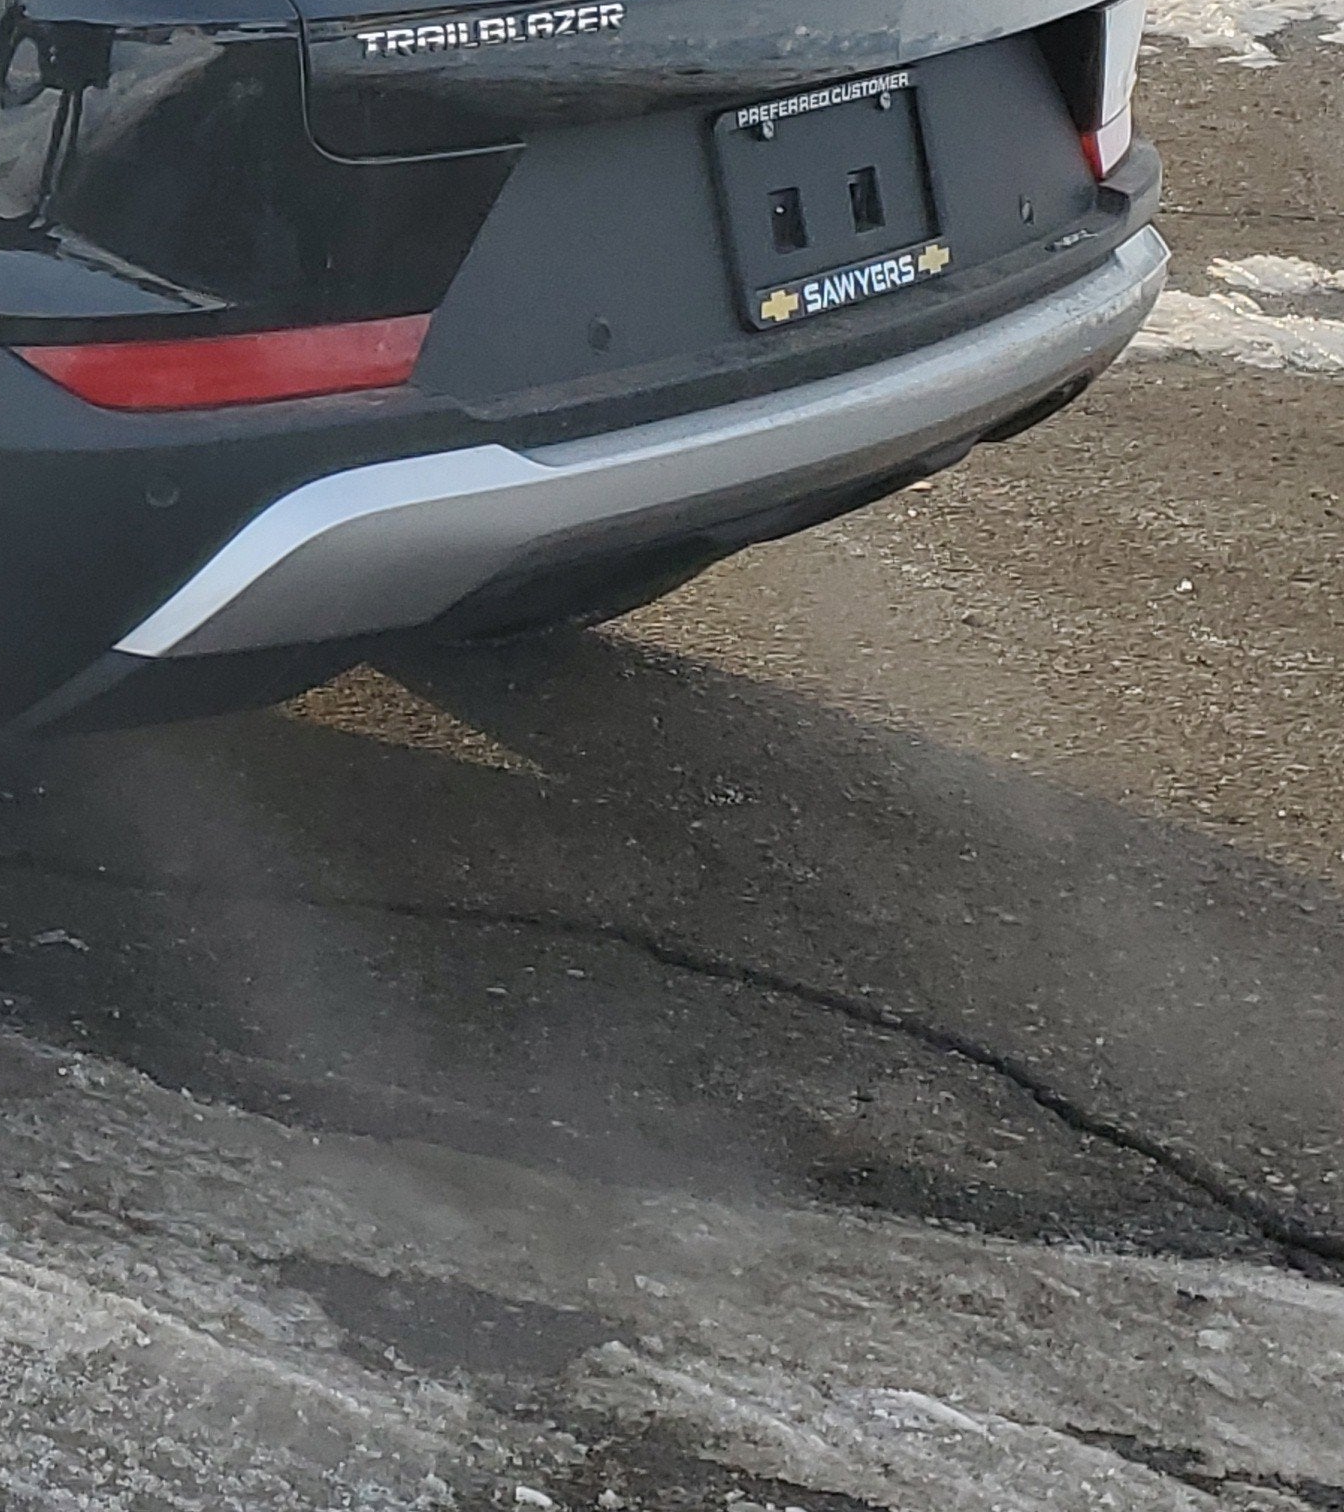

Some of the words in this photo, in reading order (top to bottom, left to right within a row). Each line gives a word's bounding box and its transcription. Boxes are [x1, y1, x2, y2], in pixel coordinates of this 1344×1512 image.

[357, 3, 626, 57] TRAILBLAZER
[737, 93, 829, 128] PREFERRED
[831, 72, 909, 104] CUSTOMER
[803, 254, 915, 313] SAWYERS
